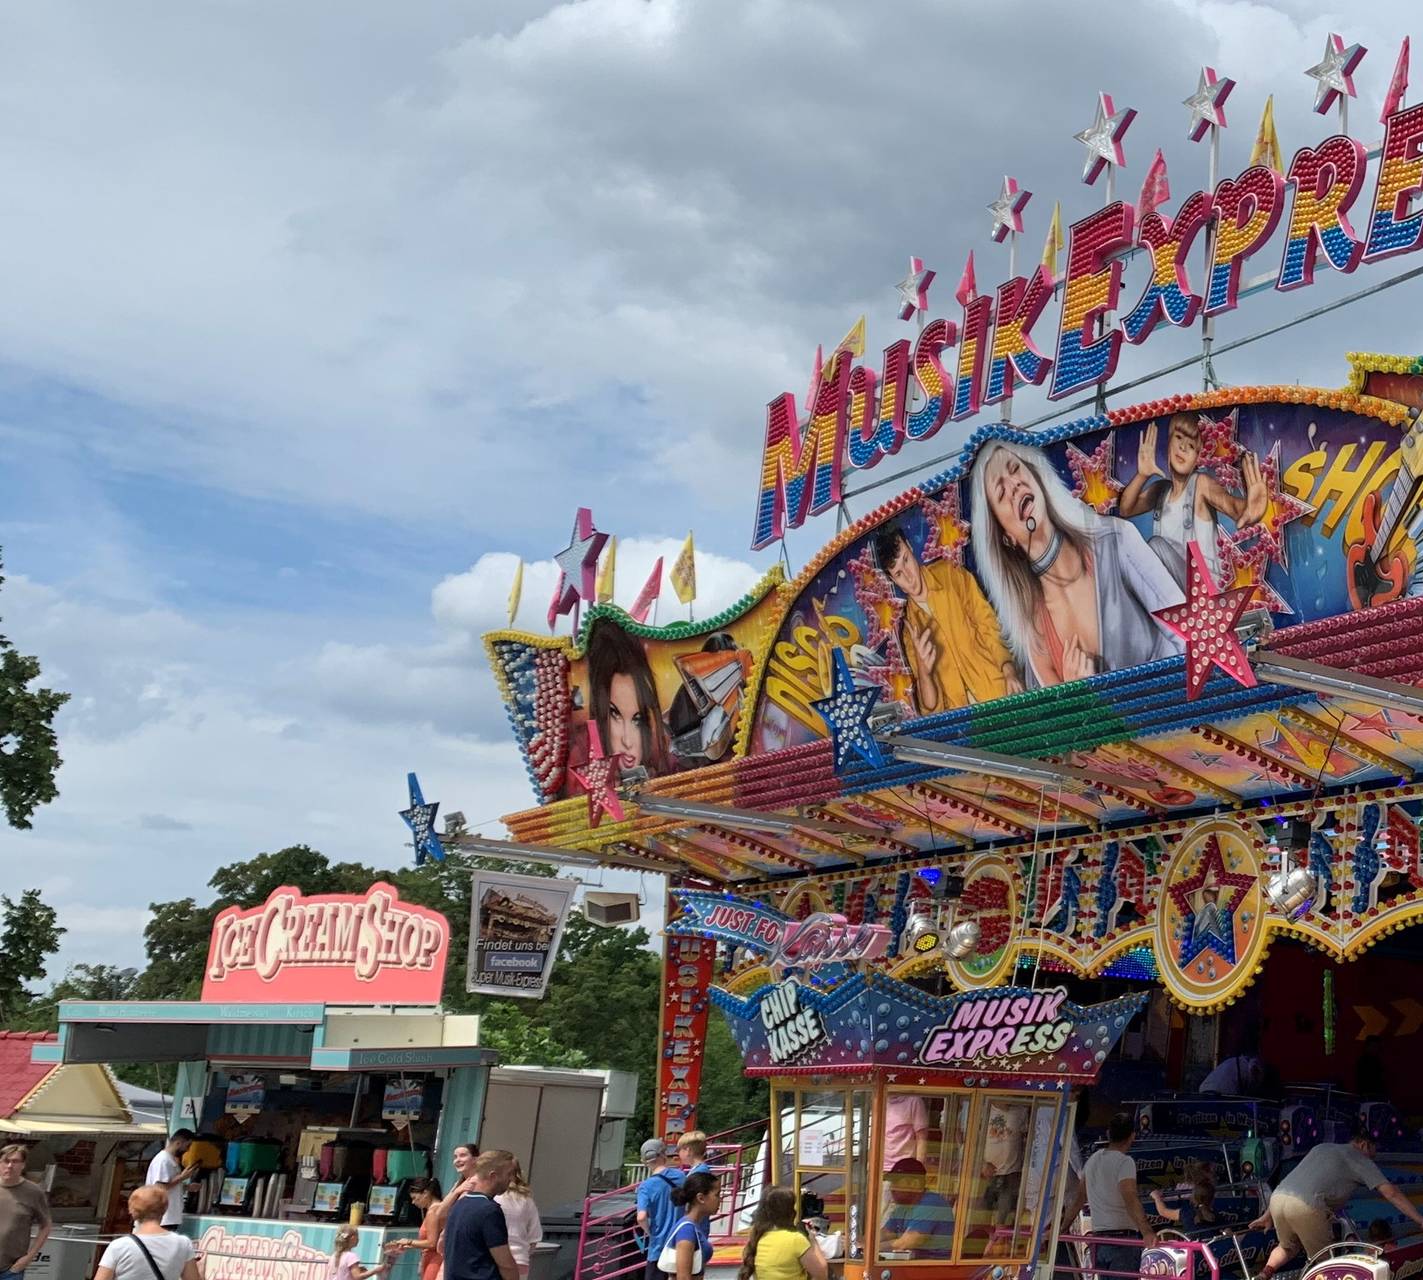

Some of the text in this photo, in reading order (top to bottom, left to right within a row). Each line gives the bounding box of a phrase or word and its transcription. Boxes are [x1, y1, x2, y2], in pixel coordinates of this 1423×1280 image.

[210, 890, 443, 981] ICE CREAM SHOP
[475, 938, 512, 951] Findet
[515, 941, 534, 951] uns
[704, 905, 780, 946] JUST FO
[490, 956, 538, 968] facebook
[760, 981, 798, 1030] CHIP
[950, 987, 1066, 1031] MUSIK
[767, 1008, 820, 1063] KASSE
[924, 1018, 1074, 1065] EXPRESS
[275, 1230, 332, 1280] SHO
